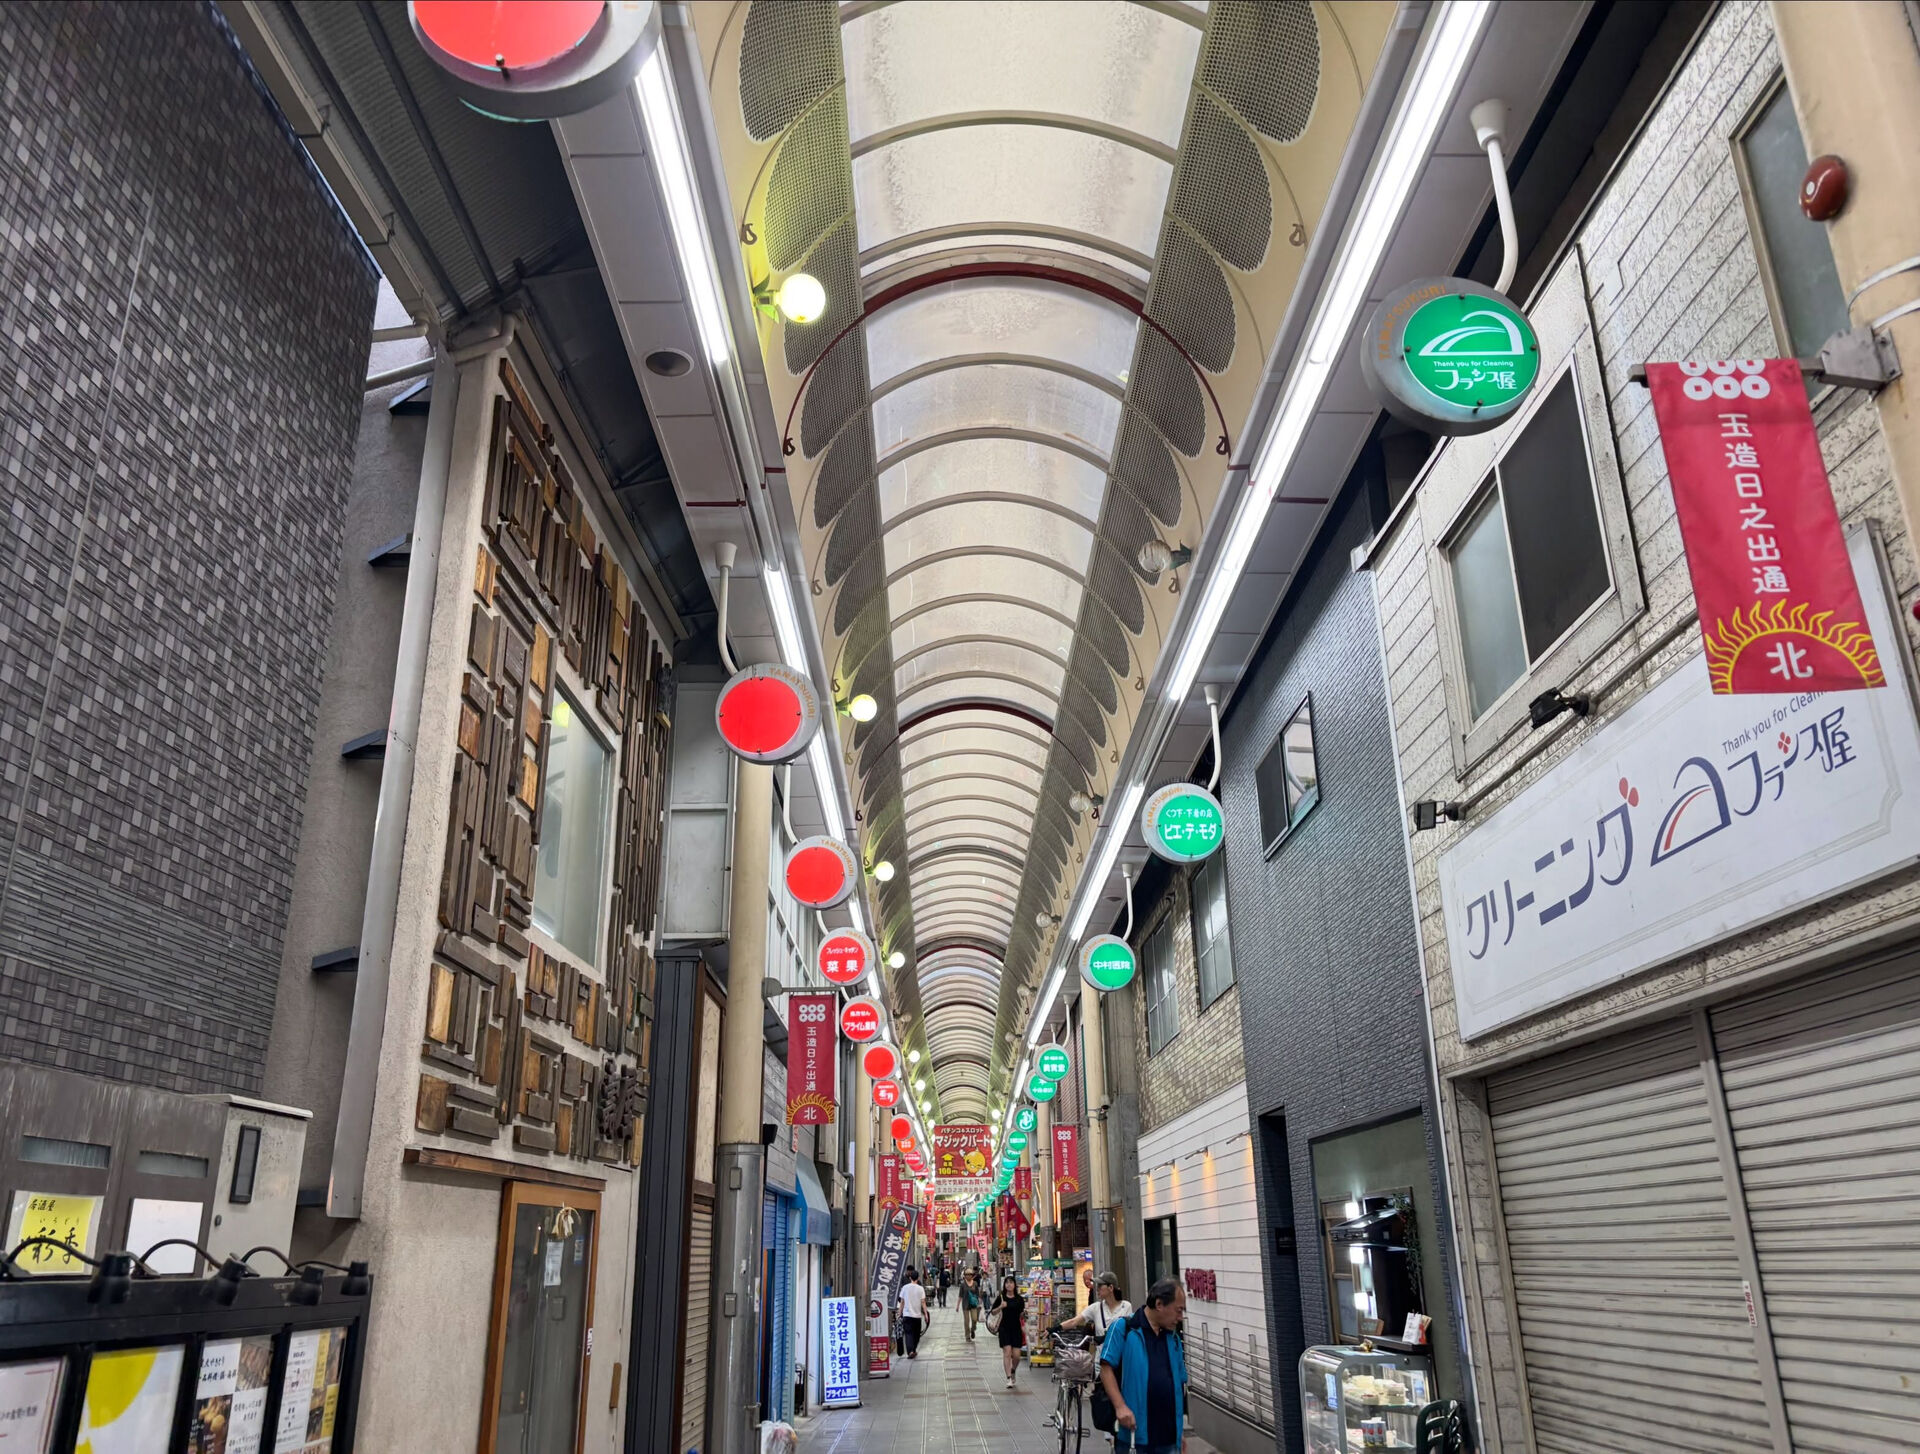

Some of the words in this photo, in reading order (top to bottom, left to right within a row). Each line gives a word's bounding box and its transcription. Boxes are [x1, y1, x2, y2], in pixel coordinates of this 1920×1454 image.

[1377, 284, 1446, 361] TAMATSUKURI
[1434, 369, 1518, 390] フランス屋
[1482, 360, 1514, 368] Cleaning
[1717, 412, 1791, 595] 玉造日之出通
[1766, 641, 1814, 681] 北
[769, 667, 816, 719] TAMATSUKURI
[1721, 727, 1752, 755] Thank
[1752, 717, 1772, 741] you
[1772, 705, 1789, 725] for
[1789, 690, 1828, 714] Clean
[1727, 705, 1857, 817] フランス屋
[1466, 776, 1640, 961] クリーニング
[805, 1026, 817, 1092] 玉造日之出通
[803, 1107, 817, 1121] 北
[935, 1134, 991, 1148] マジックバード
[29, 1198, 56, 1212] 居酒屋
[836, 1301, 851, 1384] 処方せん受付
